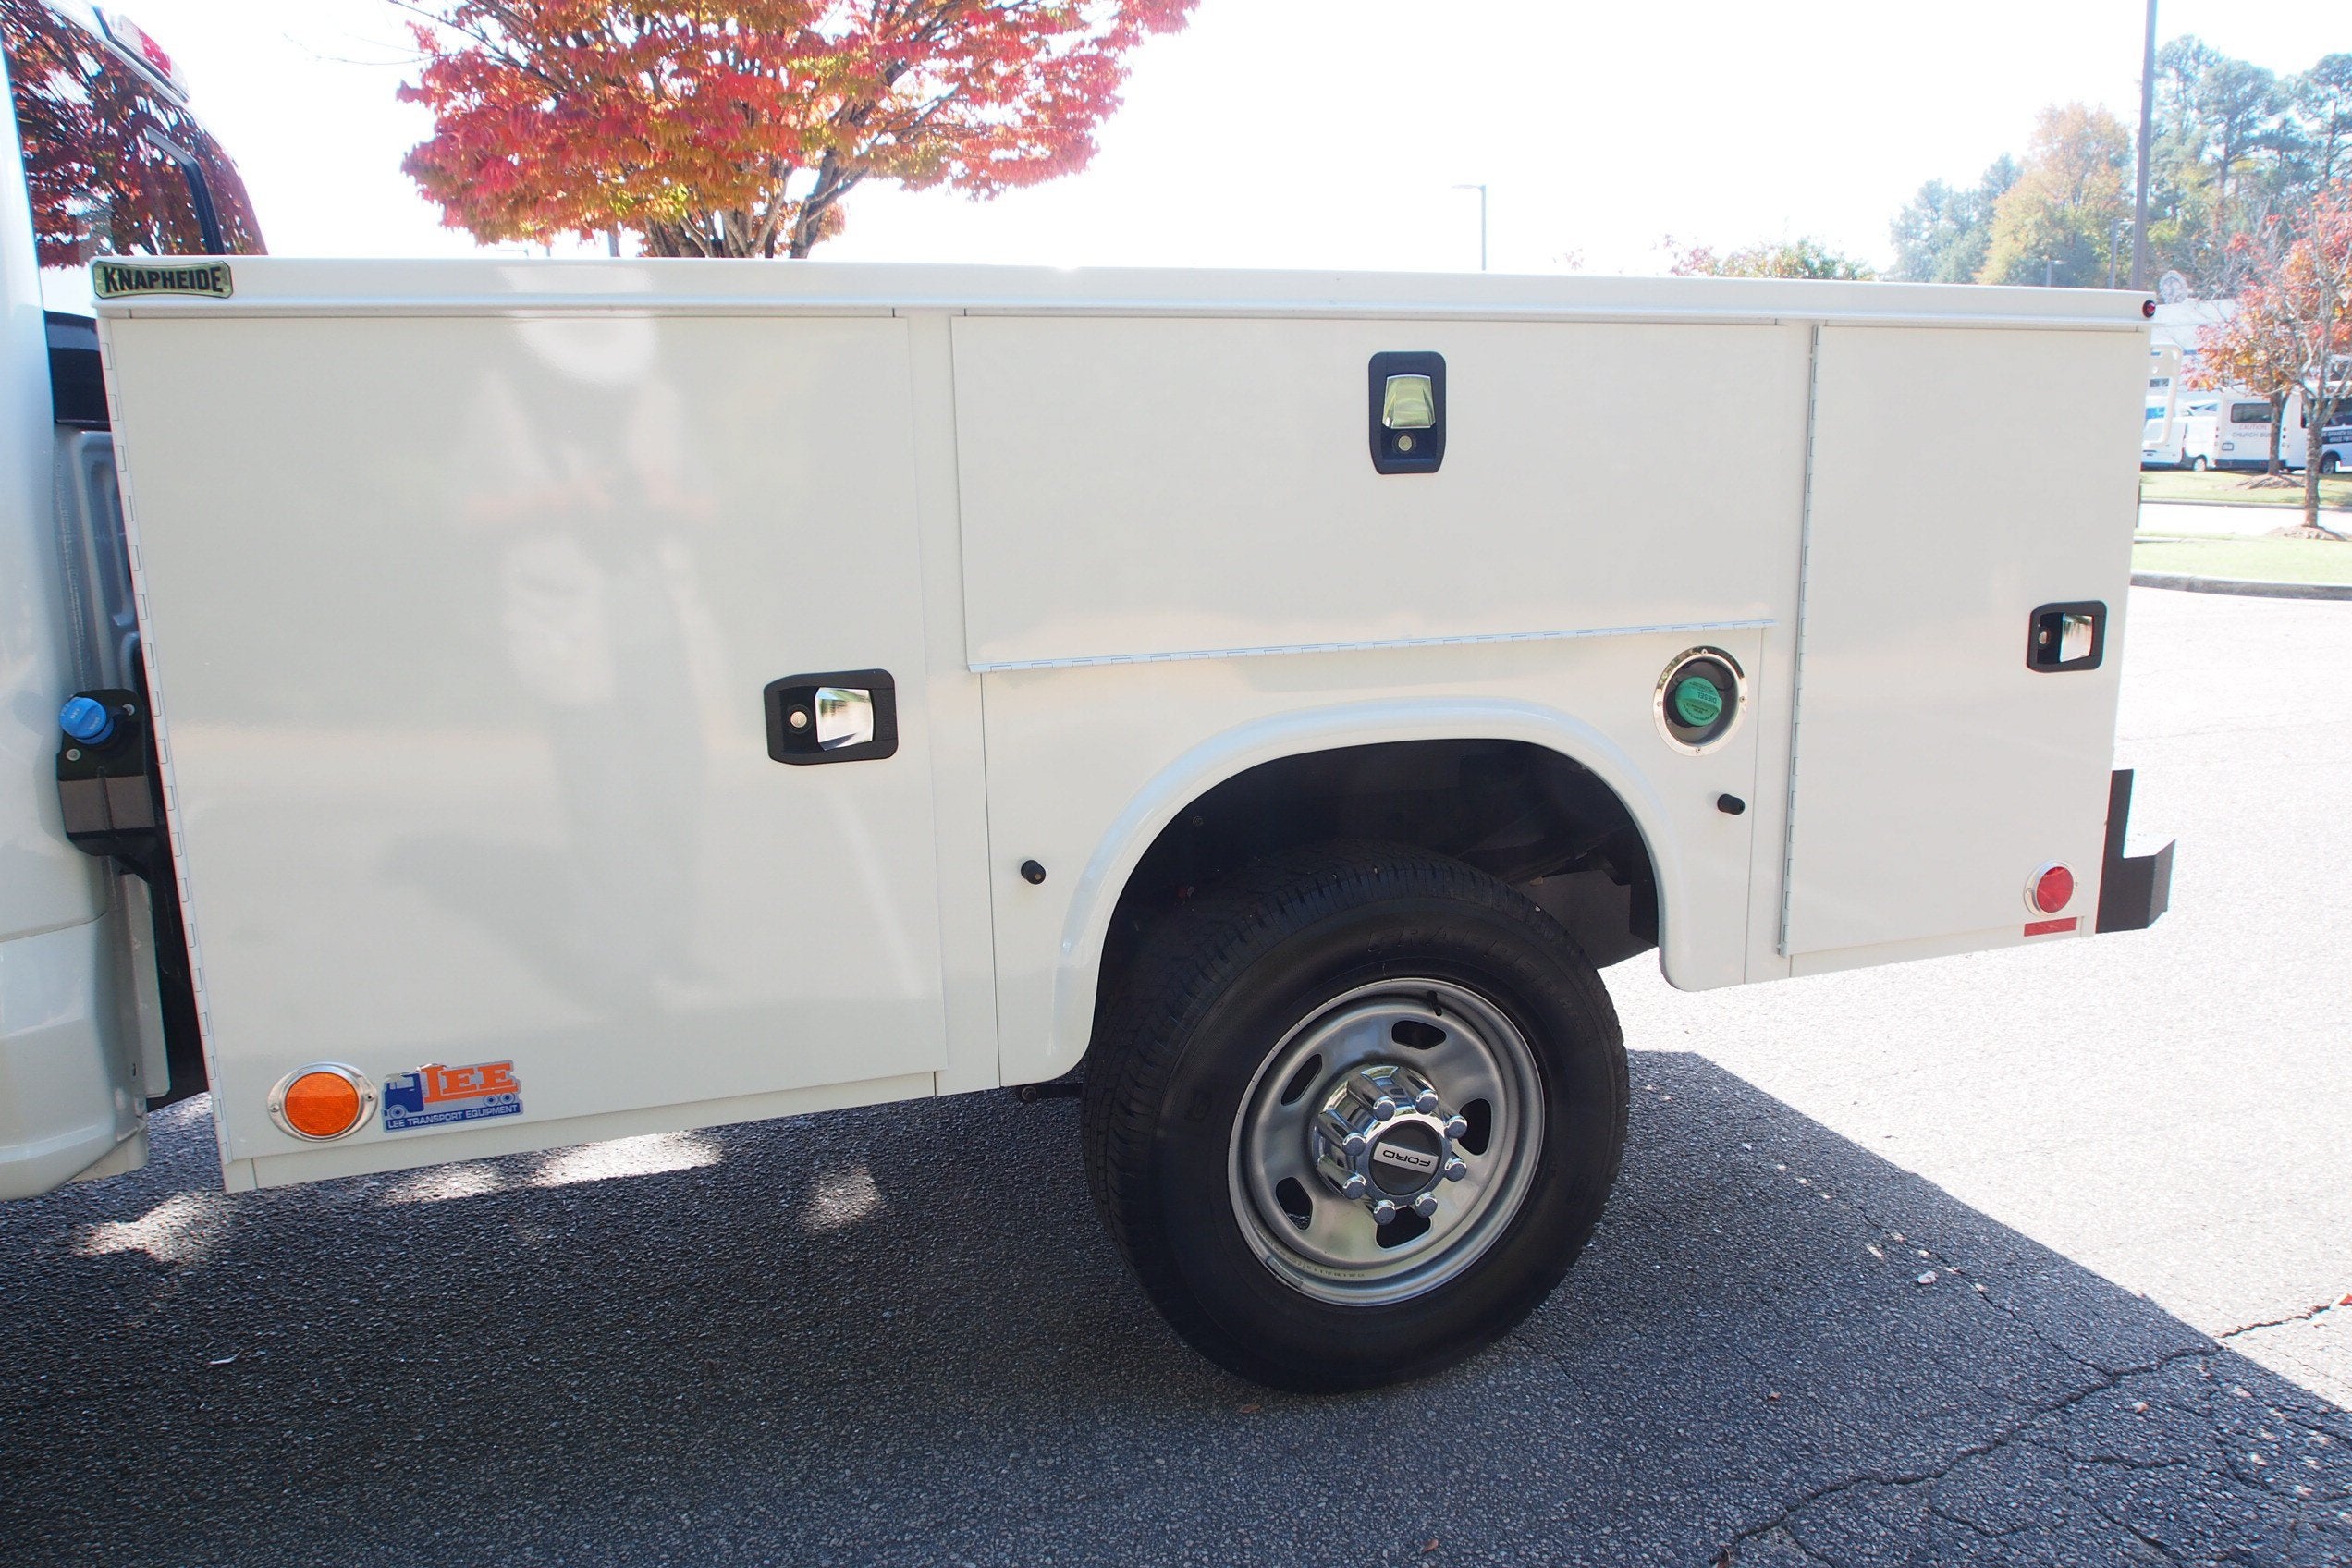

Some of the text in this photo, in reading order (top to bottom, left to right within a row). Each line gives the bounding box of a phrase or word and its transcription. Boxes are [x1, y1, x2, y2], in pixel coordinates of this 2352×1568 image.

[104, 266, 224, 293] KNAPHEIDE
[1697, 692, 1717, 704] DIESEL
[421, 1063, 519, 1103] LEE
[387, 1104, 518, 1129] LEE TRANSPORT EQUIPMENT
[1382, 1149, 1431, 1167] FORD
